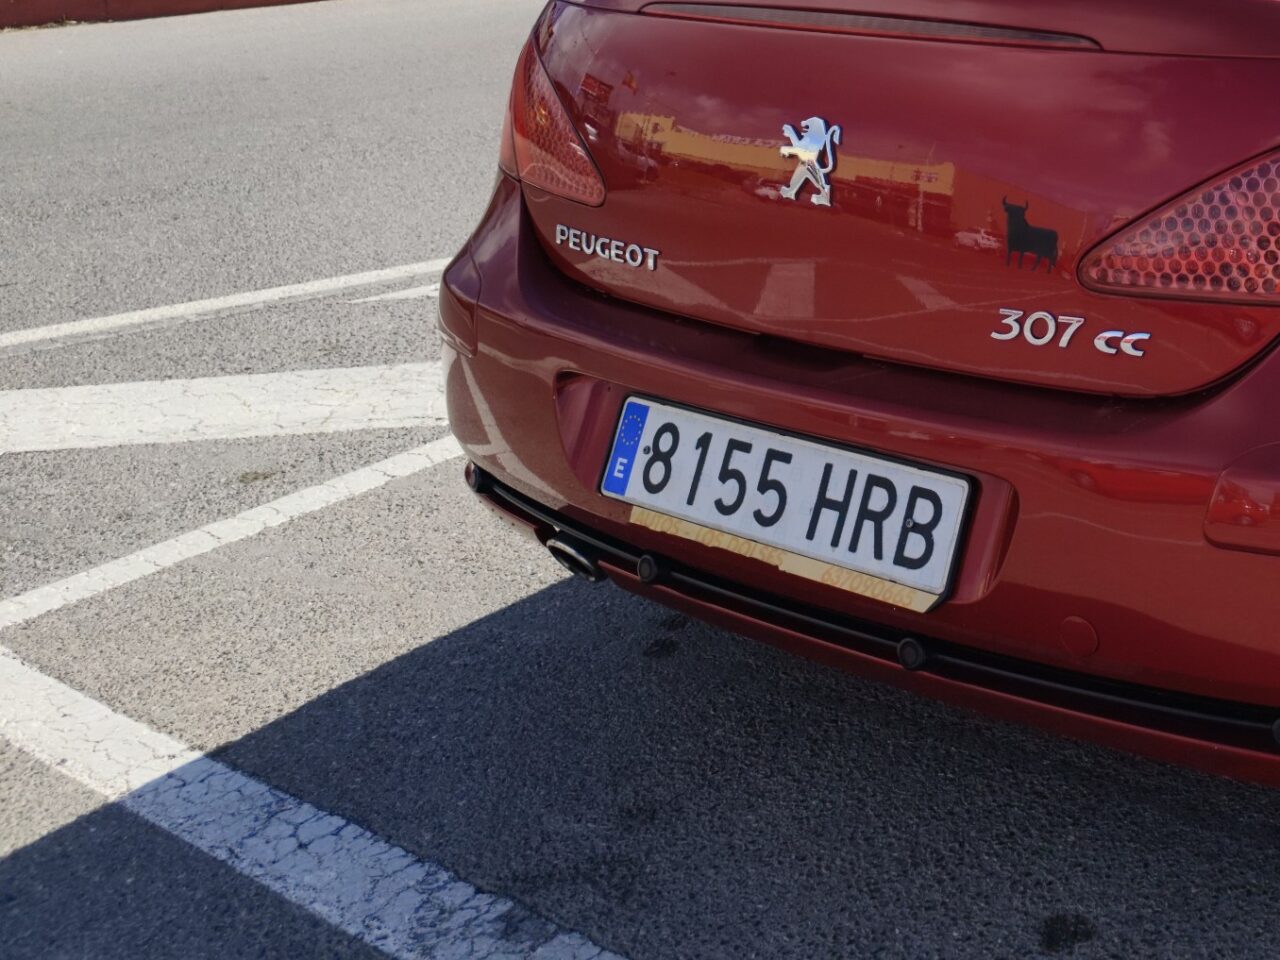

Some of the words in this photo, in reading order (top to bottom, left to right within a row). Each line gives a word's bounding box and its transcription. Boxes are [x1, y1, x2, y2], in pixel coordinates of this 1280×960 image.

[556, 224, 659, 271] PEUGEOT
[990, 308, 1085, 348] 307
[613, 458, 628, 479] E
[642, 421, 794, 528] 8155
[805, 462, 943, 571] HRB
